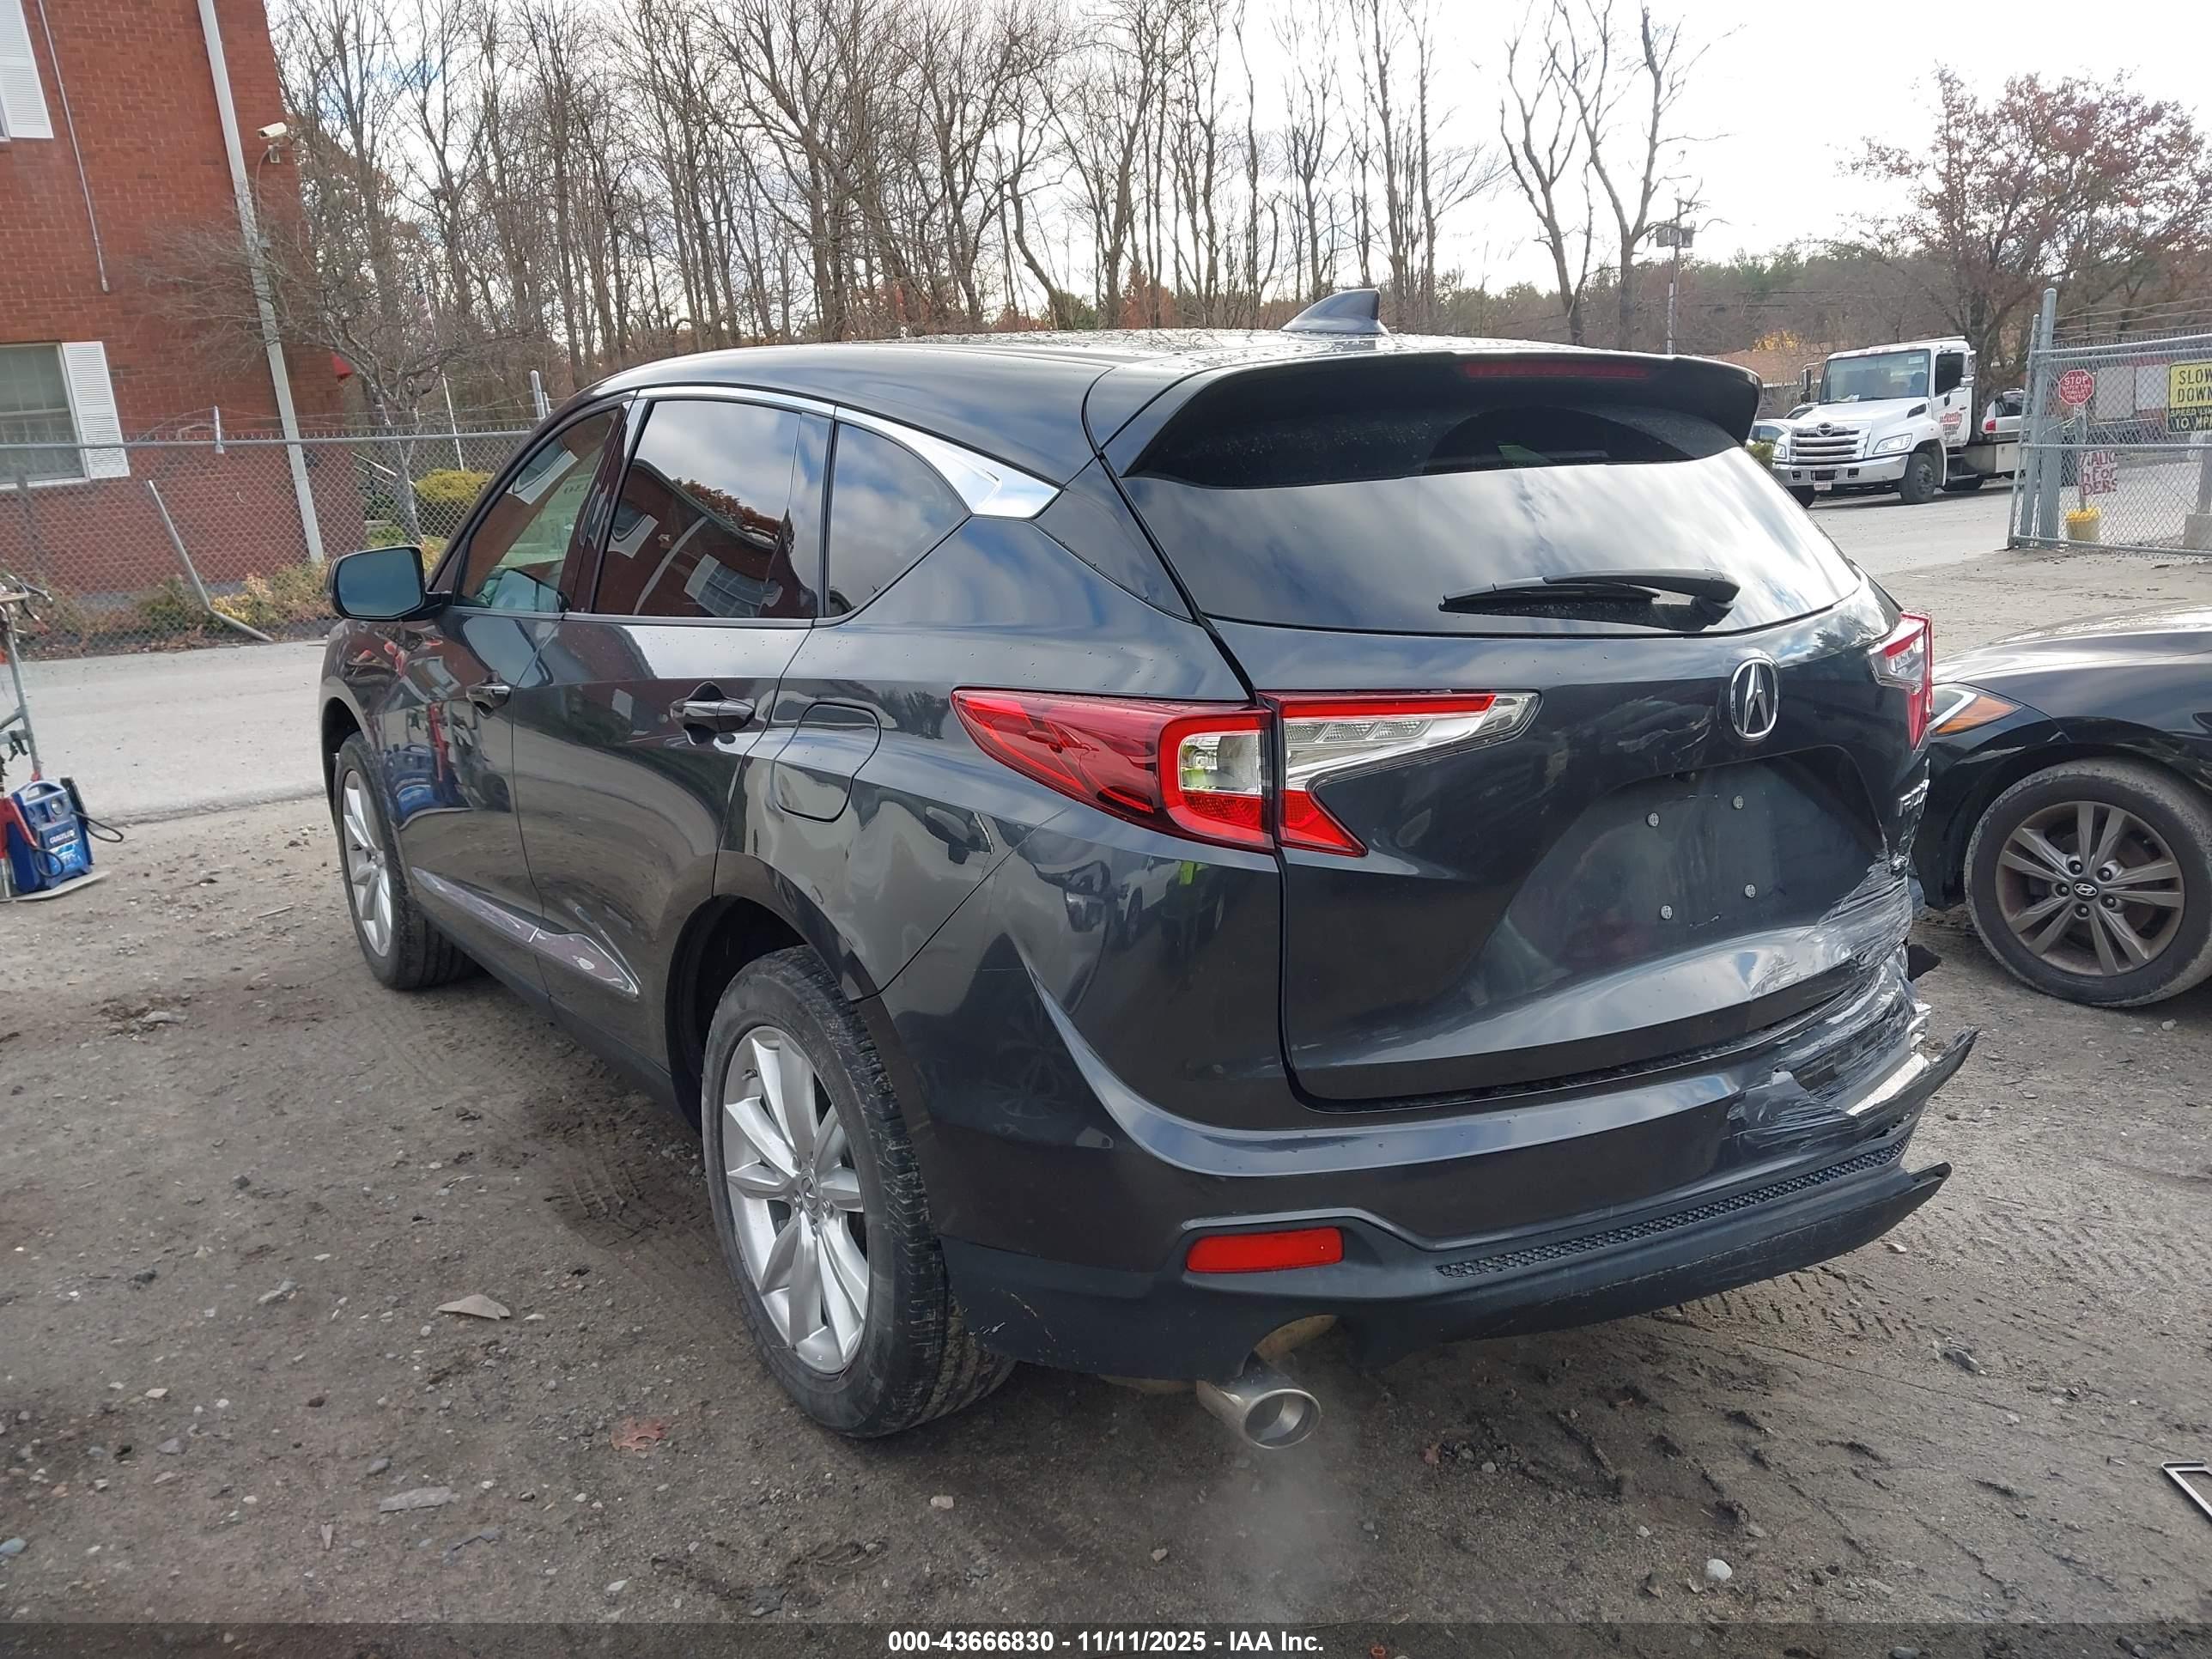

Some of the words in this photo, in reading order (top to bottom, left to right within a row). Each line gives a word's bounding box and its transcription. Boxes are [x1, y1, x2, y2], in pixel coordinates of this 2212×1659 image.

[2064, 375, 2088, 386] STOP
[2179, 368, 2212, 386] SLOW
[2171, 408, 2197, 417] SPEED
[2176, 417, 2190, 429] 10
